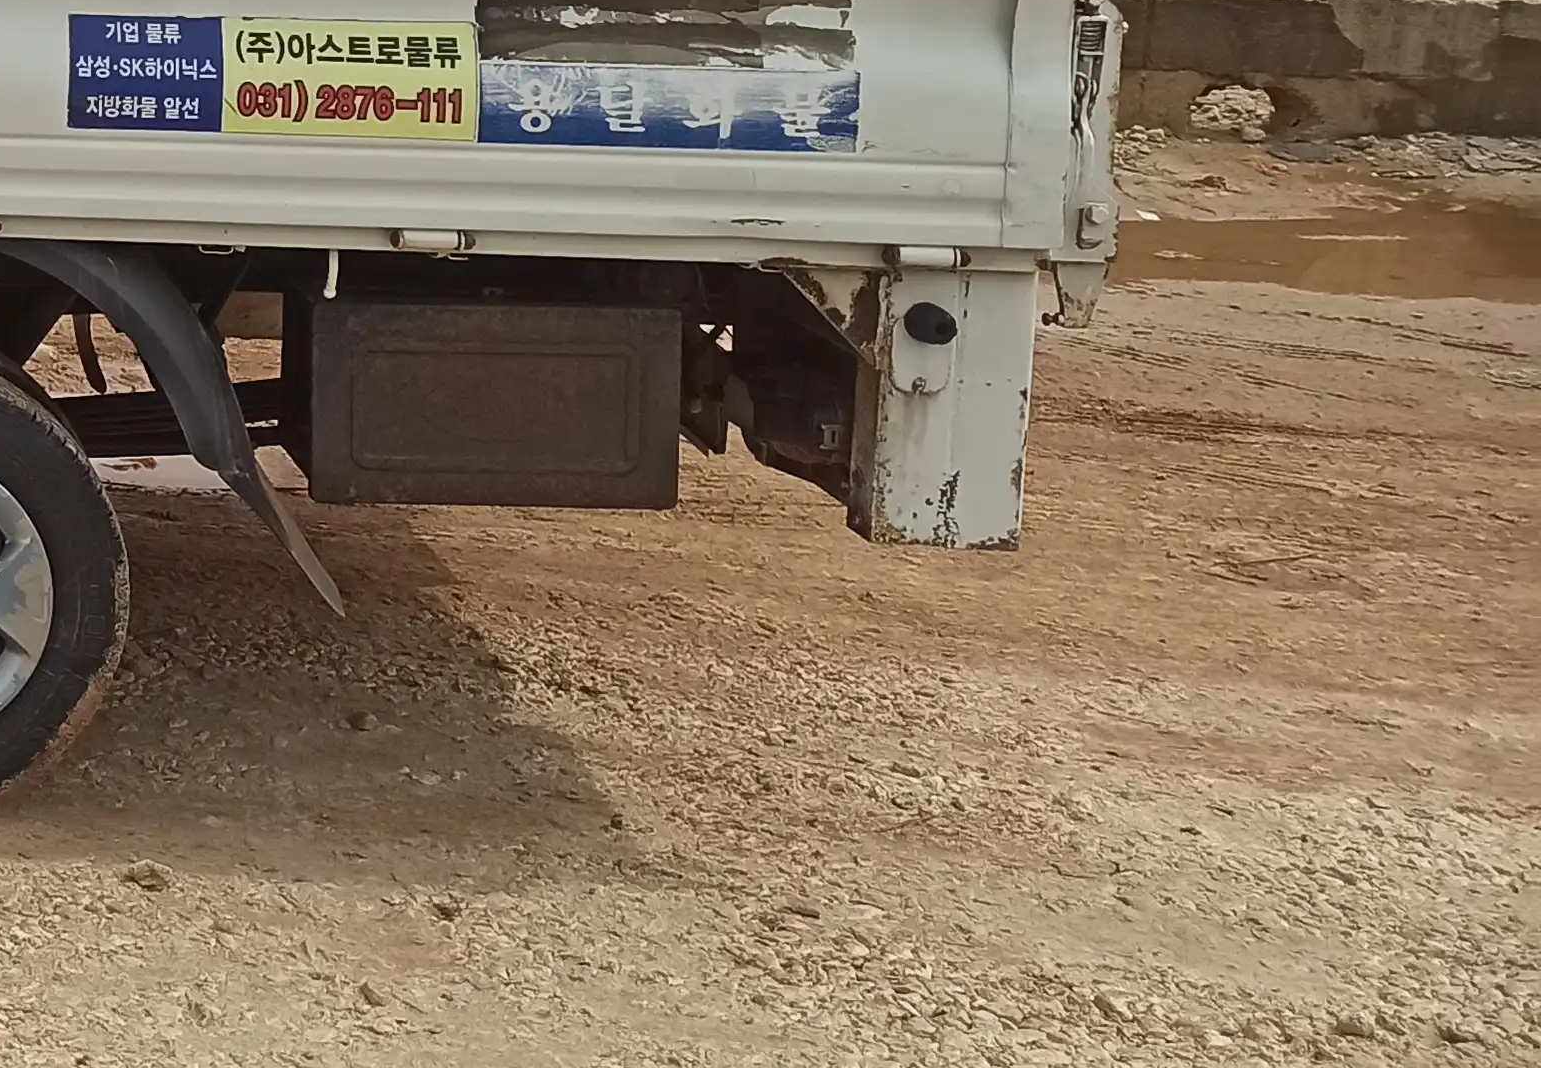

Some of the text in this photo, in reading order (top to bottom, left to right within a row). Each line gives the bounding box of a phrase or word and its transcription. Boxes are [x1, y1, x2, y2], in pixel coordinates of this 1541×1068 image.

[105, 21, 182, 44] 기업 물류
[235, 30, 462, 69] (주)아스트로물류
[75, 55, 218, 81] 삼성·SK하이닉스
[86, 94, 200, 120] 지방화물 알선
[236, 79, 463, 124] 031) 2876-111
